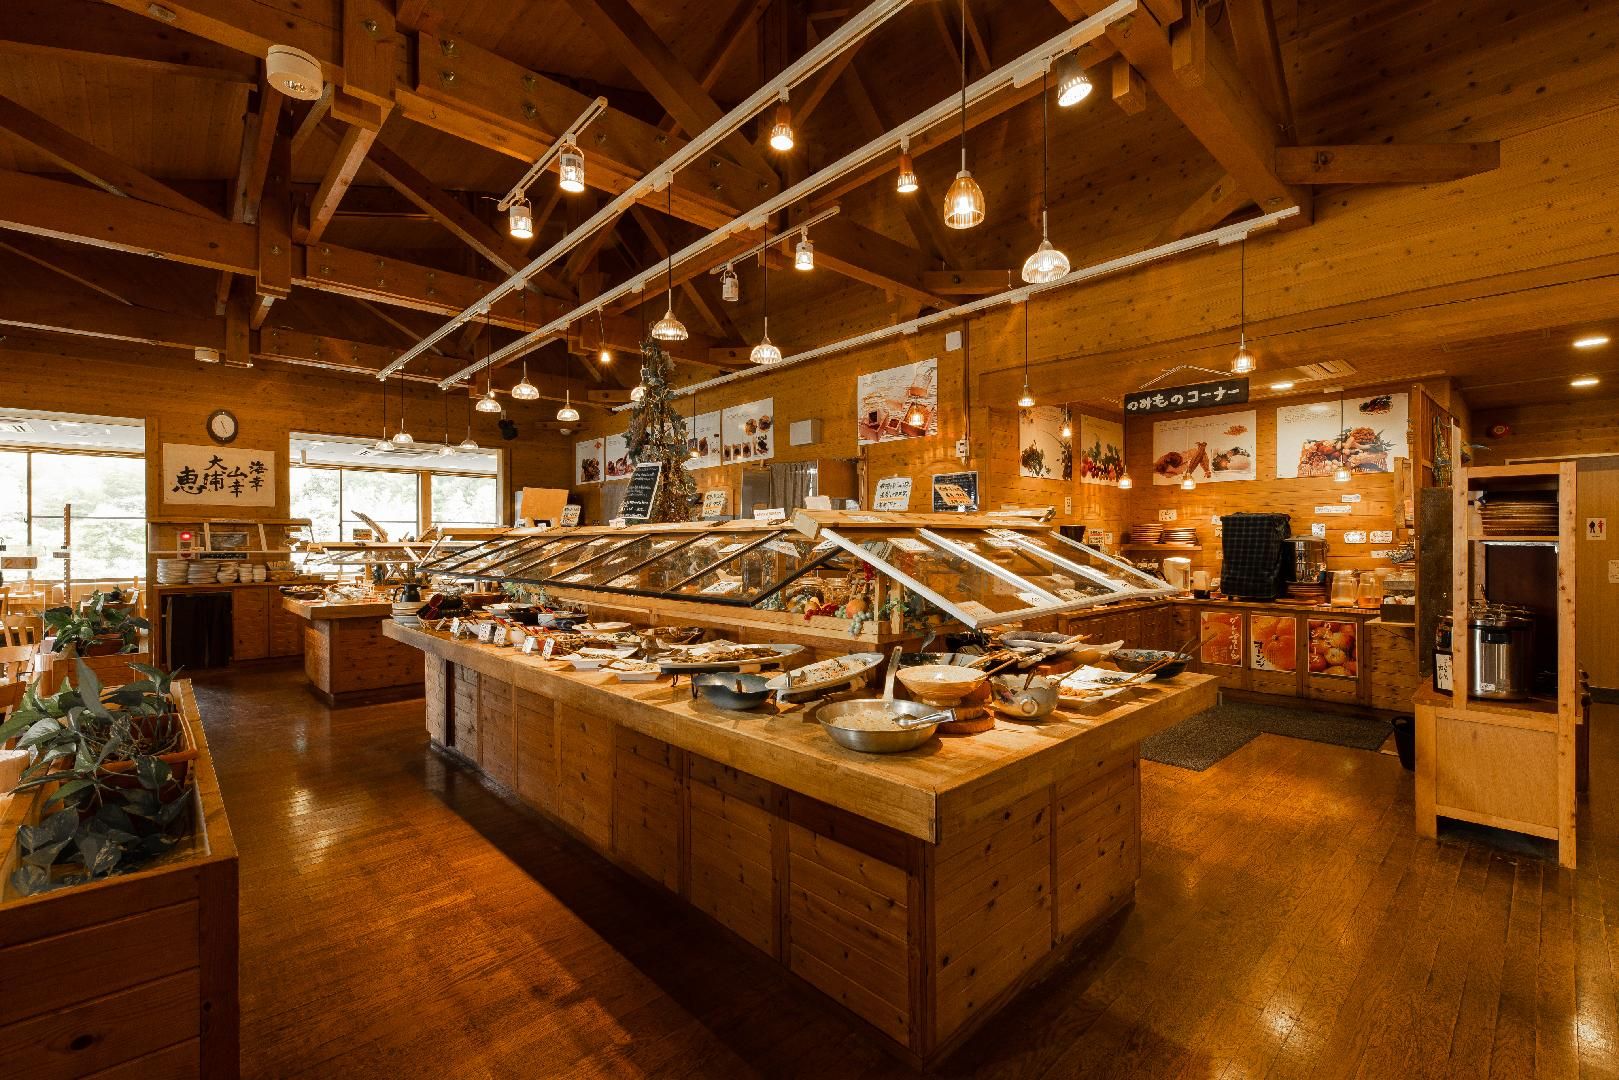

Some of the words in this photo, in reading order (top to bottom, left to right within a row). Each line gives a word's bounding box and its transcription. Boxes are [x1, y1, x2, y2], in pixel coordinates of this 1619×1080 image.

[1127, 387, 1240, 411] のみものコーナー
[172, 465, 208, 495] 恵
[227, 466, 248, 498] 山幸
[1310, 629, 1321, 664] ジュース
